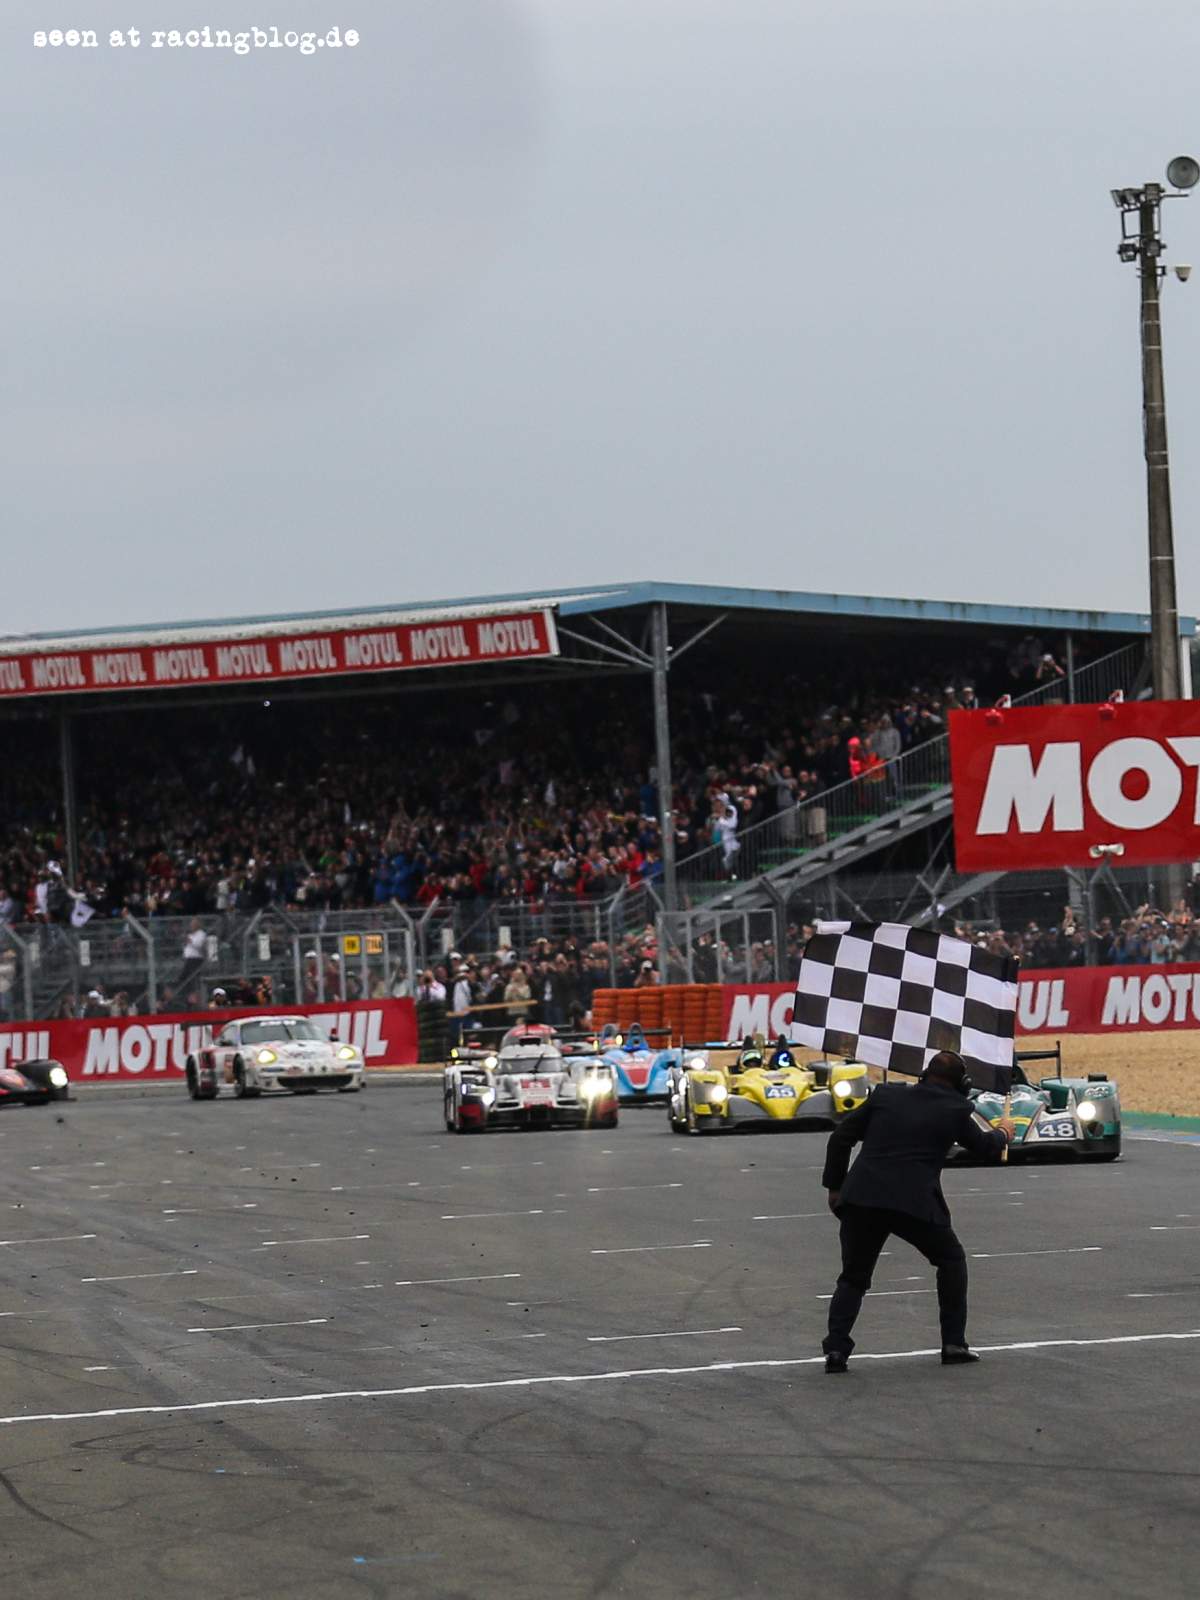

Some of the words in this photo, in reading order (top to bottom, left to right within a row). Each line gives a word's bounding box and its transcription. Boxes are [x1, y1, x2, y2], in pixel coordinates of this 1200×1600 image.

[0, 661, 25, 689] TUL
[32, 656, 86, 687] MOTUL
[92, 653, 147, 684] MOTUL
[153, 648, 209, 681] MOTUL
[216, 643, 272, 677] MOTUL
[279, 638, 337, 672] MOTUL
[344, 632, 403, 666] MOTUL
[410, 625, 471, 661] MOTUL
[478, 619, 540, 655] MOTUL
[83, 1024, 213, 1075] MOTU
[1039, 1123, 1075, 1137] 48
